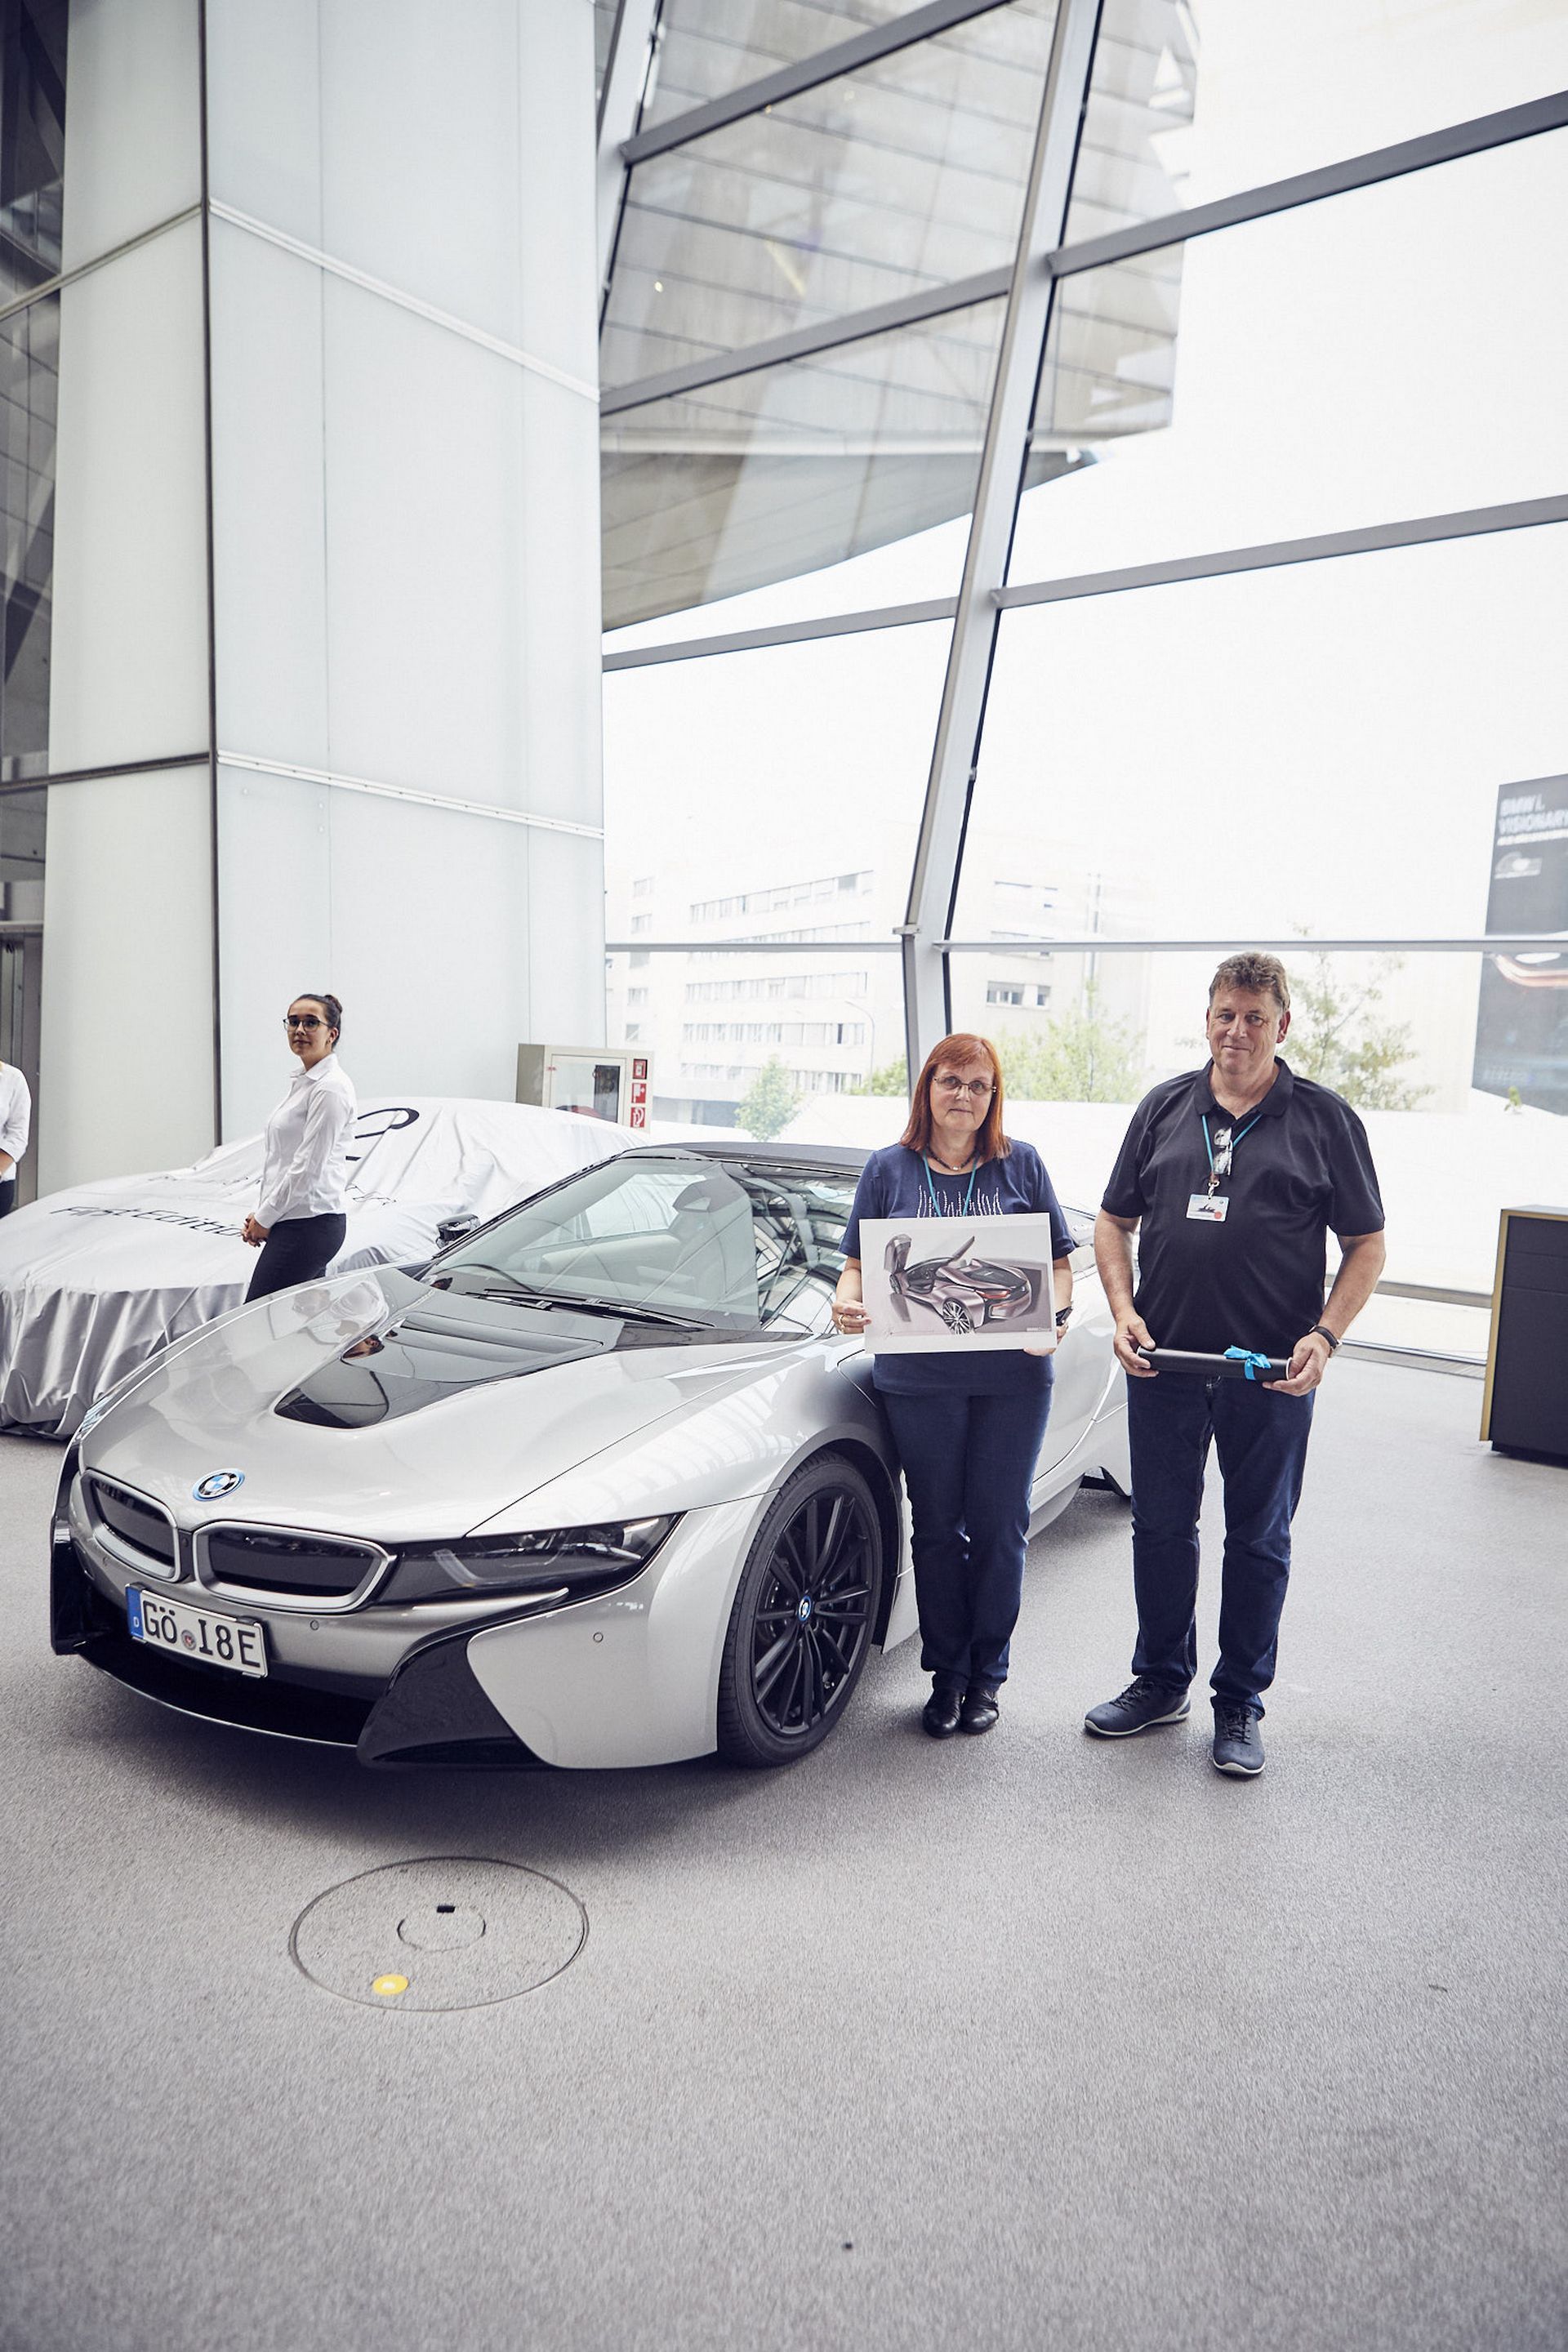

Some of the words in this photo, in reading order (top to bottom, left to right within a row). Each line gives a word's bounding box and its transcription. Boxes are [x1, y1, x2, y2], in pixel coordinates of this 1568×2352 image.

[131, 1209, 243, 1237] Editio
[132, 1616, 140, 1628] D
[142, 1599, 177, 1644] GÖ
[198, 1619, 261, 1668] I8E
